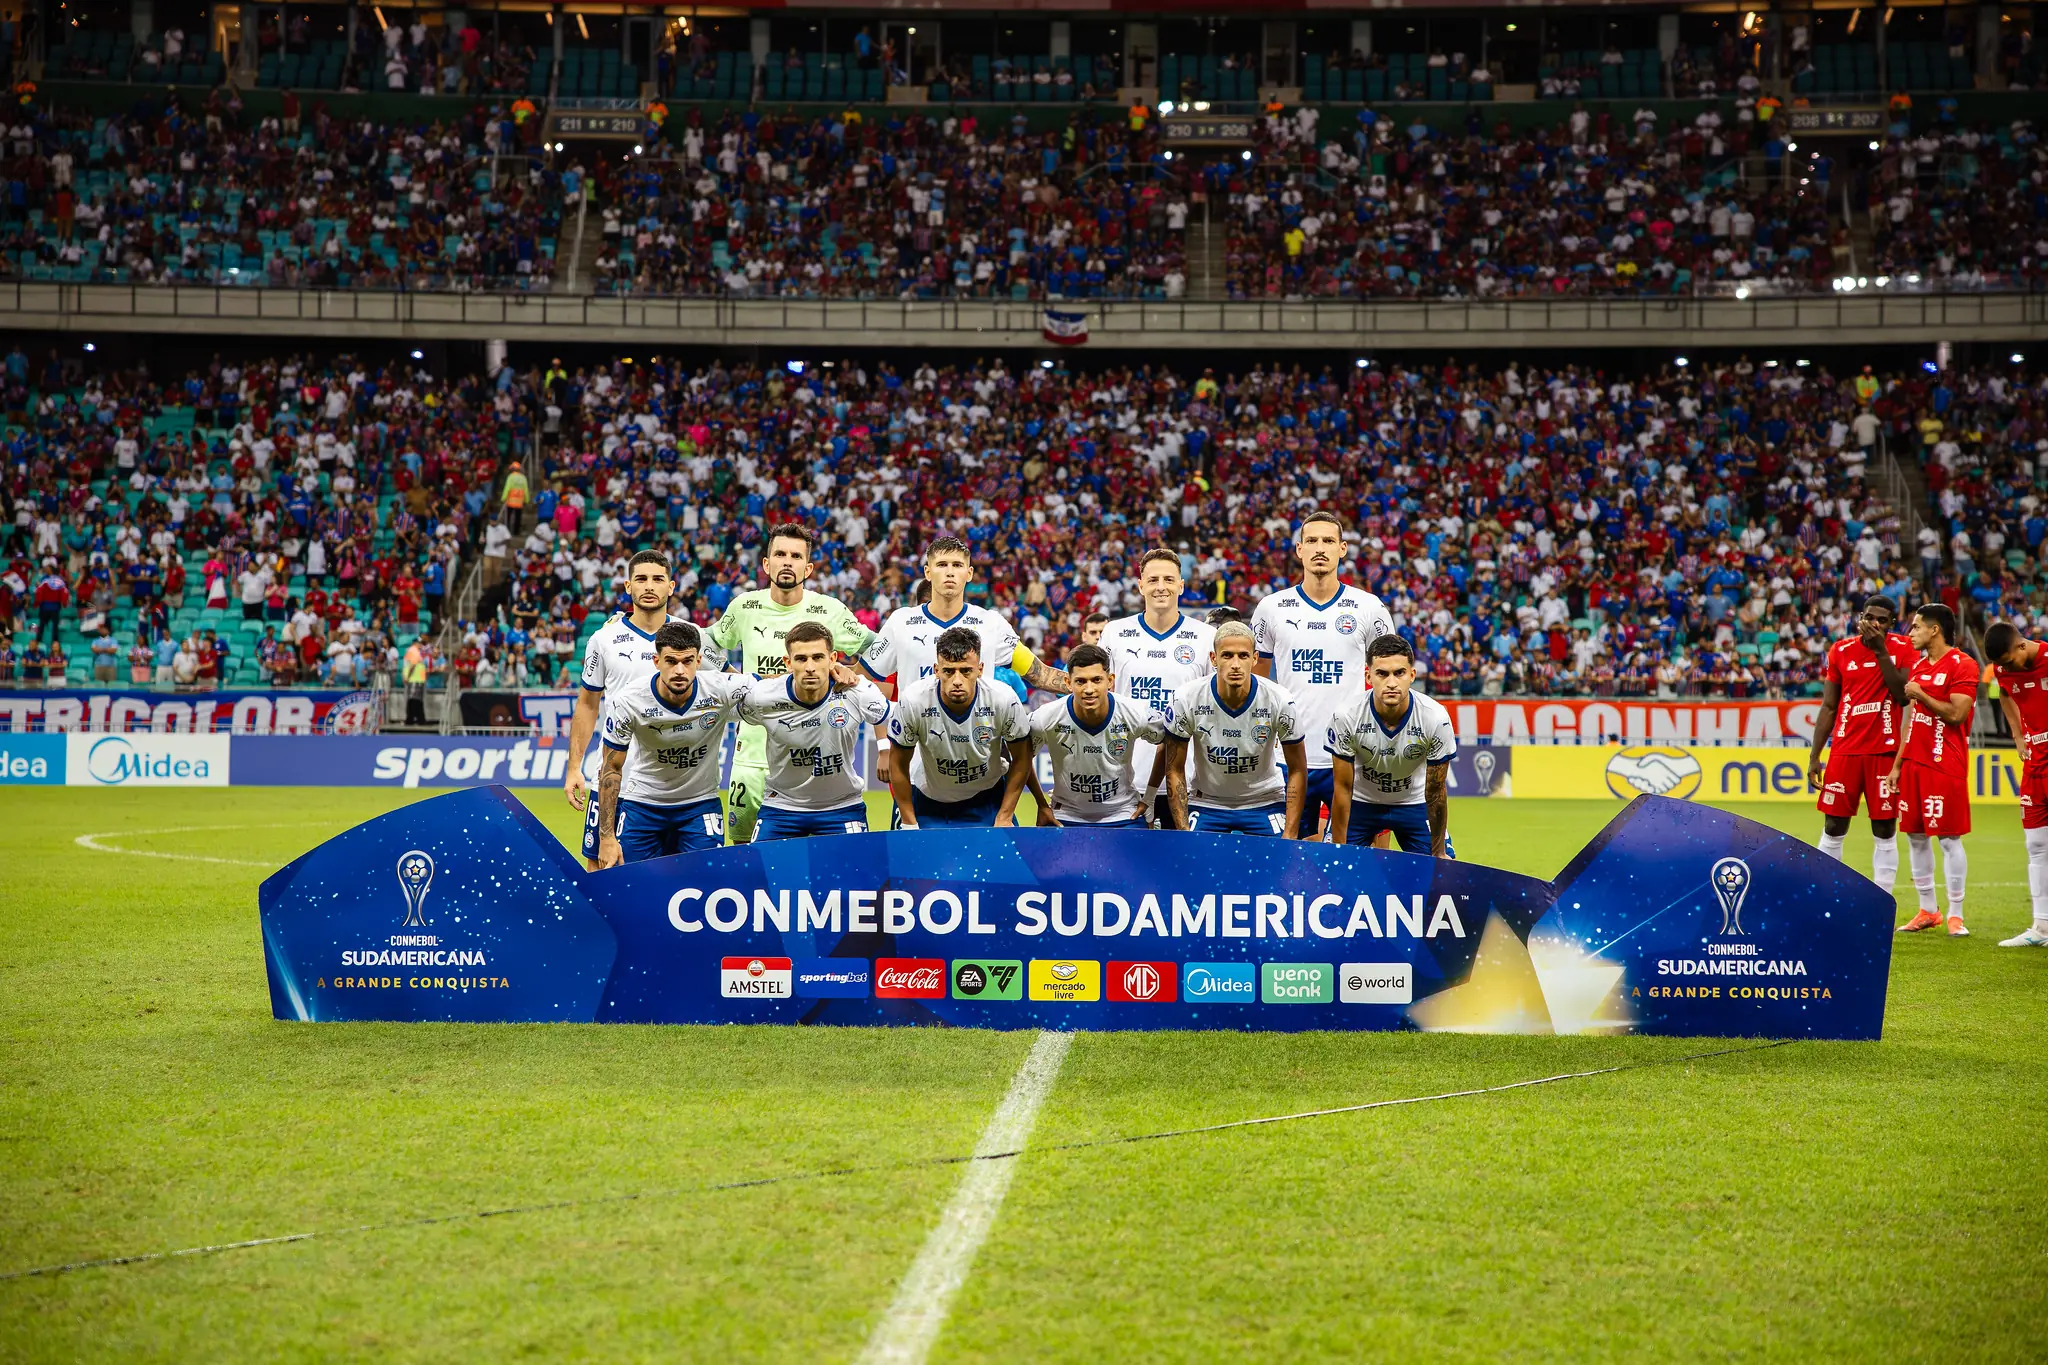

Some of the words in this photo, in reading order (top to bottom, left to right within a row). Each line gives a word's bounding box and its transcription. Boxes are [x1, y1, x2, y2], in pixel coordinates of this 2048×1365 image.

[561, 118, 581, 131] 211
[612, 118, 636, 131] 210
[1292, 649, 1323, 660] VIVA
[1292, 661, 1343, 672] SORTE
[1130, 677, 1162, 688] VIVA
[1308, 673, 1343, 684] .BET
[1131, 689, 1174, 700] SORT
[657, 746, 690, 756] VIVA
[790, 746, 821, 758] VIVA
[1206, 746, 1238, 756] VIVA
[108, 753, 209, 778] Midea
[792, 753, 843, 767] SORTE
[936, 758, 968, 768] VIVA
[1207, 755, 1259, 766] SORTE
[937, 763, 989, 776] SORTE
[1224, 765, 1259, 774] .BET
[1362, 765, 1392, 780] VIVA
[955, 771, 987, 784] .BET
[1070, 772, 1101, 783] VIVA
[1362, 772, 1412, 787] SORTE
[1070, 778, 1119, 793] SORTE
[730, 781, 746, 808] 22
[1088, 790, 1118, 802] .BET
[1924, 799, 1944, 819] 33
[668, 888, 996, 935] CONMEBOL
[1014, 891, 1467, 939] SUDAMERICANA
[341, 950, 486, 966] SUDAMERICANA
[1657, 960, 1807, 976] SUDAMERICANA
[799, 972, 867, 983] sportingbet
[878, 967, 943, 989] Coca-Cola
[961, 970, 979, 981] EA
[1273, 969, 1322, 981] ueno
[317, 977, 326, 988] A
[333, 977, 402, 988] GRANDE
[409, 977, 510, 990] CONQUISTA
[729, 981, 784, 994] AMSTEL
[1043, 982, 1085, 991] mercado
[1126, 967, 1157, 998] MG
[1198, 976, 1252, 992] Midea
[1365, 976, 1405, 988] world
[1054, 991, 1074, 999] livre
[1273, 982, 1321, 997] bank
[1631, 987, 1641, 997] A
[1649, 987, 1721, 998] GRANDE
[1729, 987, 1832, 1000] CONQUISTA
